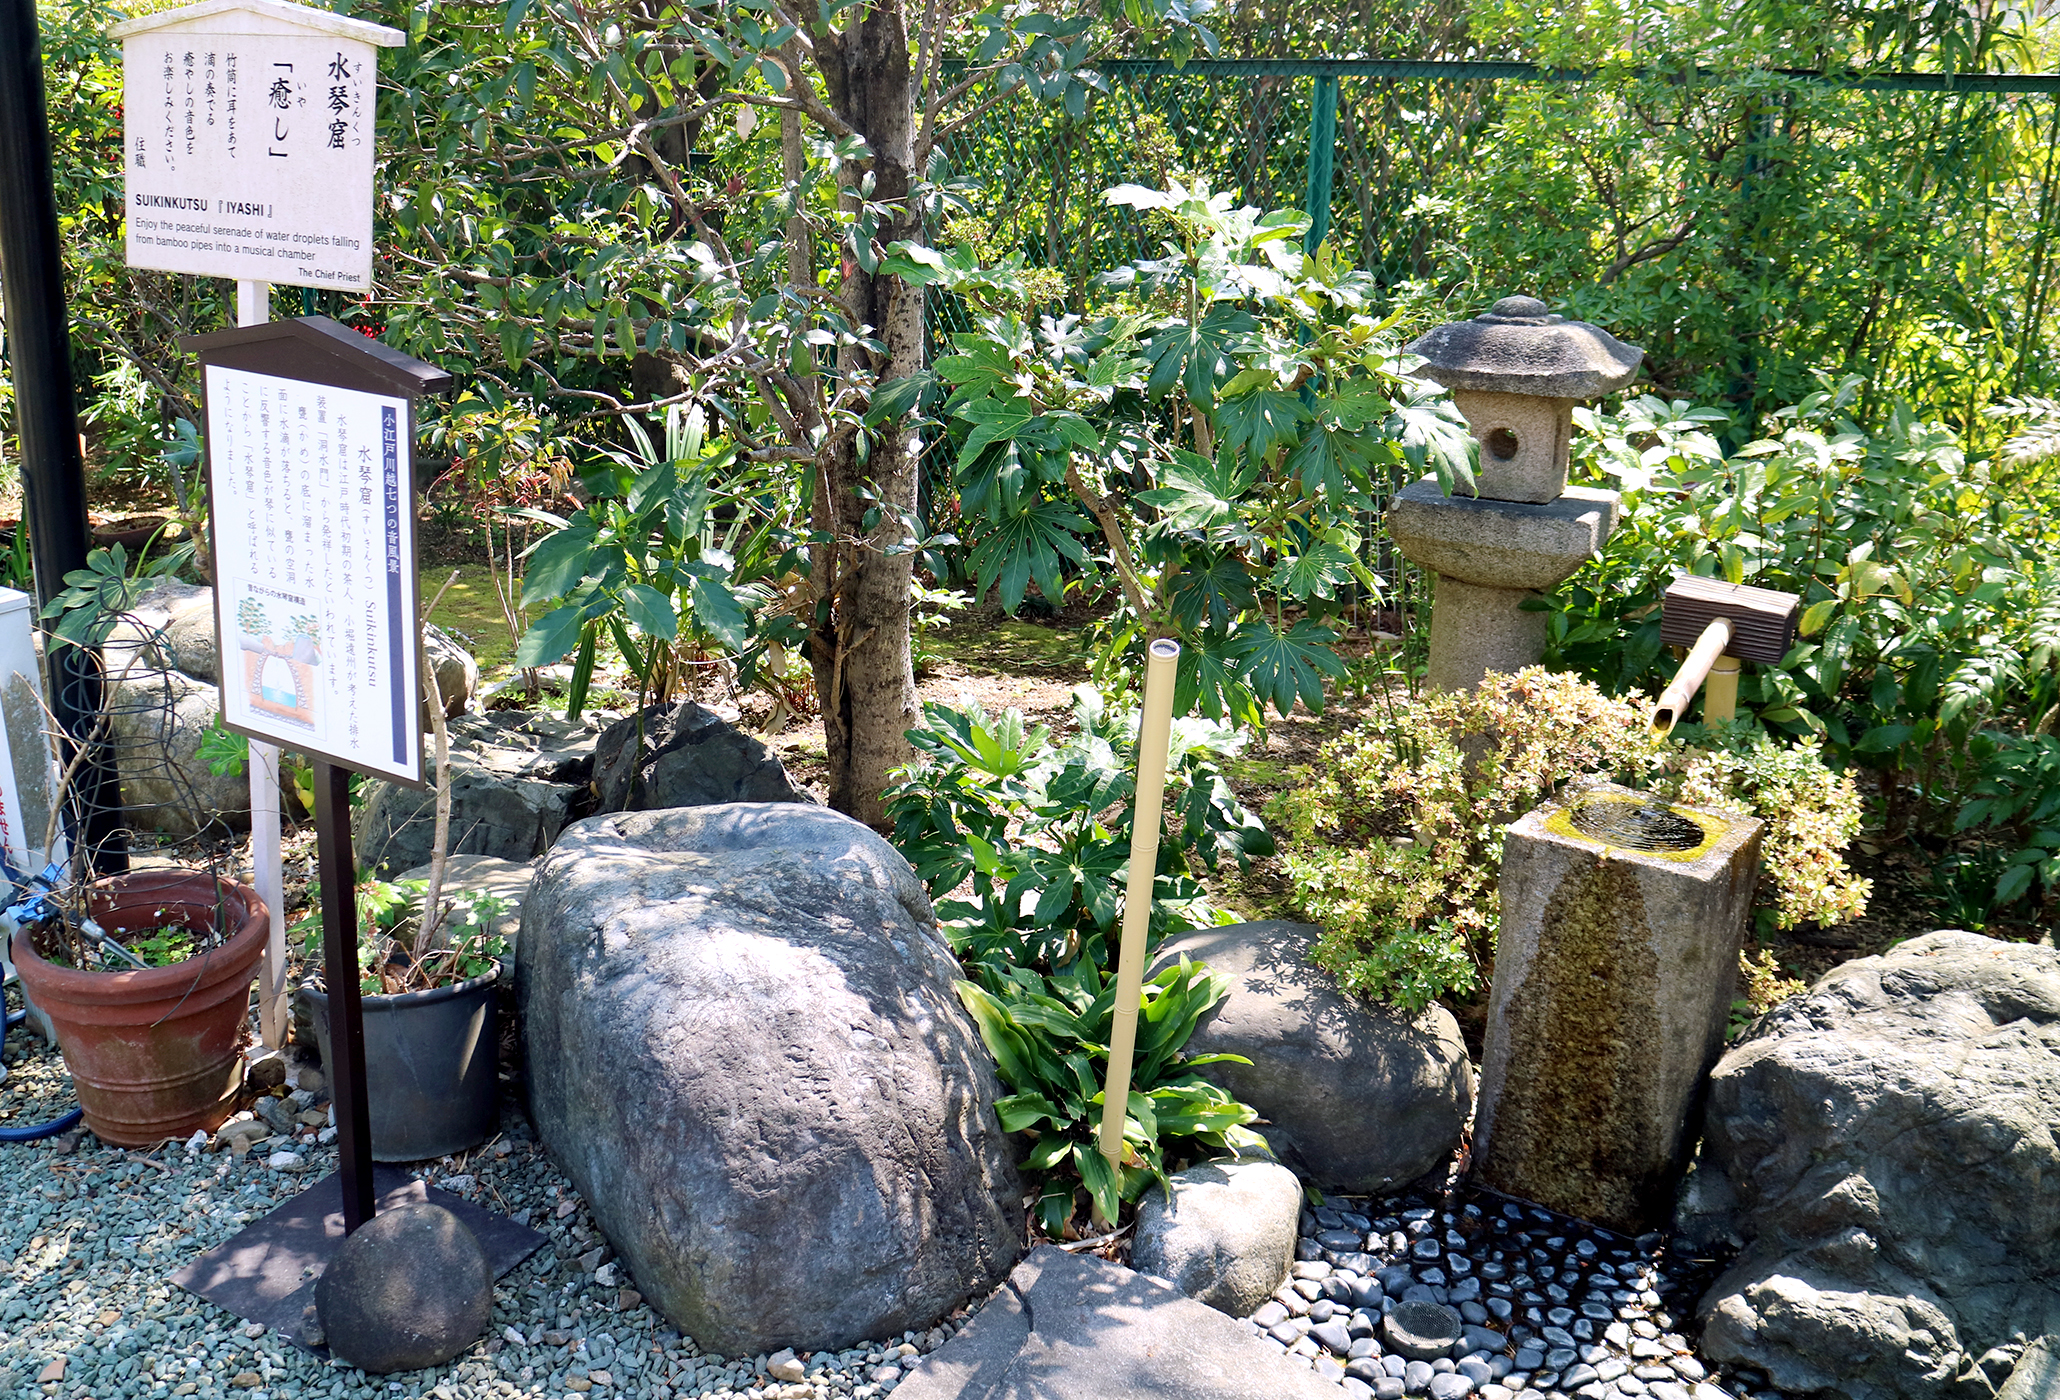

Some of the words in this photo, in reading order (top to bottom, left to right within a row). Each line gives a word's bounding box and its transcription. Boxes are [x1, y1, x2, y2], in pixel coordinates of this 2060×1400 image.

[163, 51, 175, 172] お楽しみください。
[183, 51, 195, 155] 癒やしの音色を
[204, 52, 216, 126] 滴の奏でる
[226, 53, 237, 159] 竹筒に耳をあて
[268, 62, 293, 157] 「癒し」
[297, 81, 306, 108] いや
[327, 52, 350, 149] 水琴窟
[352, 62, 362, 147] すいきんくつ
[134, 136, 146, 169] 住職
[135, 194, 208, 212] SUIKINKUTSU
[135, 217, 157, 230] Enjoy
[160, 220, 172, 230] the
[176, 222, 210, 237] peaceful
[213, 225, 251, 238] serenade
[255, 228, 264, 239] of
[266, 230, 289, 242] water
[293, 232, 329, 247] droplets
[332, 235, 359, 250] falling
[135, 234, 154, 245] from
[156, 235, 188, 248] bamboo
[191, 239, 213, 253] pipes
[216, 241, 232, 252] into
[234, 245, 240, 253] a
[242, 245, 274, 257] musical
[277, 248, 315, 261] chamber
[299, 267, 312, 278] The
[315, 269, 335, 279] Chief
[338, 271, 360, 282] Priest
[224, 379, 237, 495] ようになりました。
[260, 386, 277, 579] に反響する音色が琴に似ている
[383, 413, 399, 574] 小江戸川越七つの音風景
[365, 600, 377, 687] Suikinkutsu
